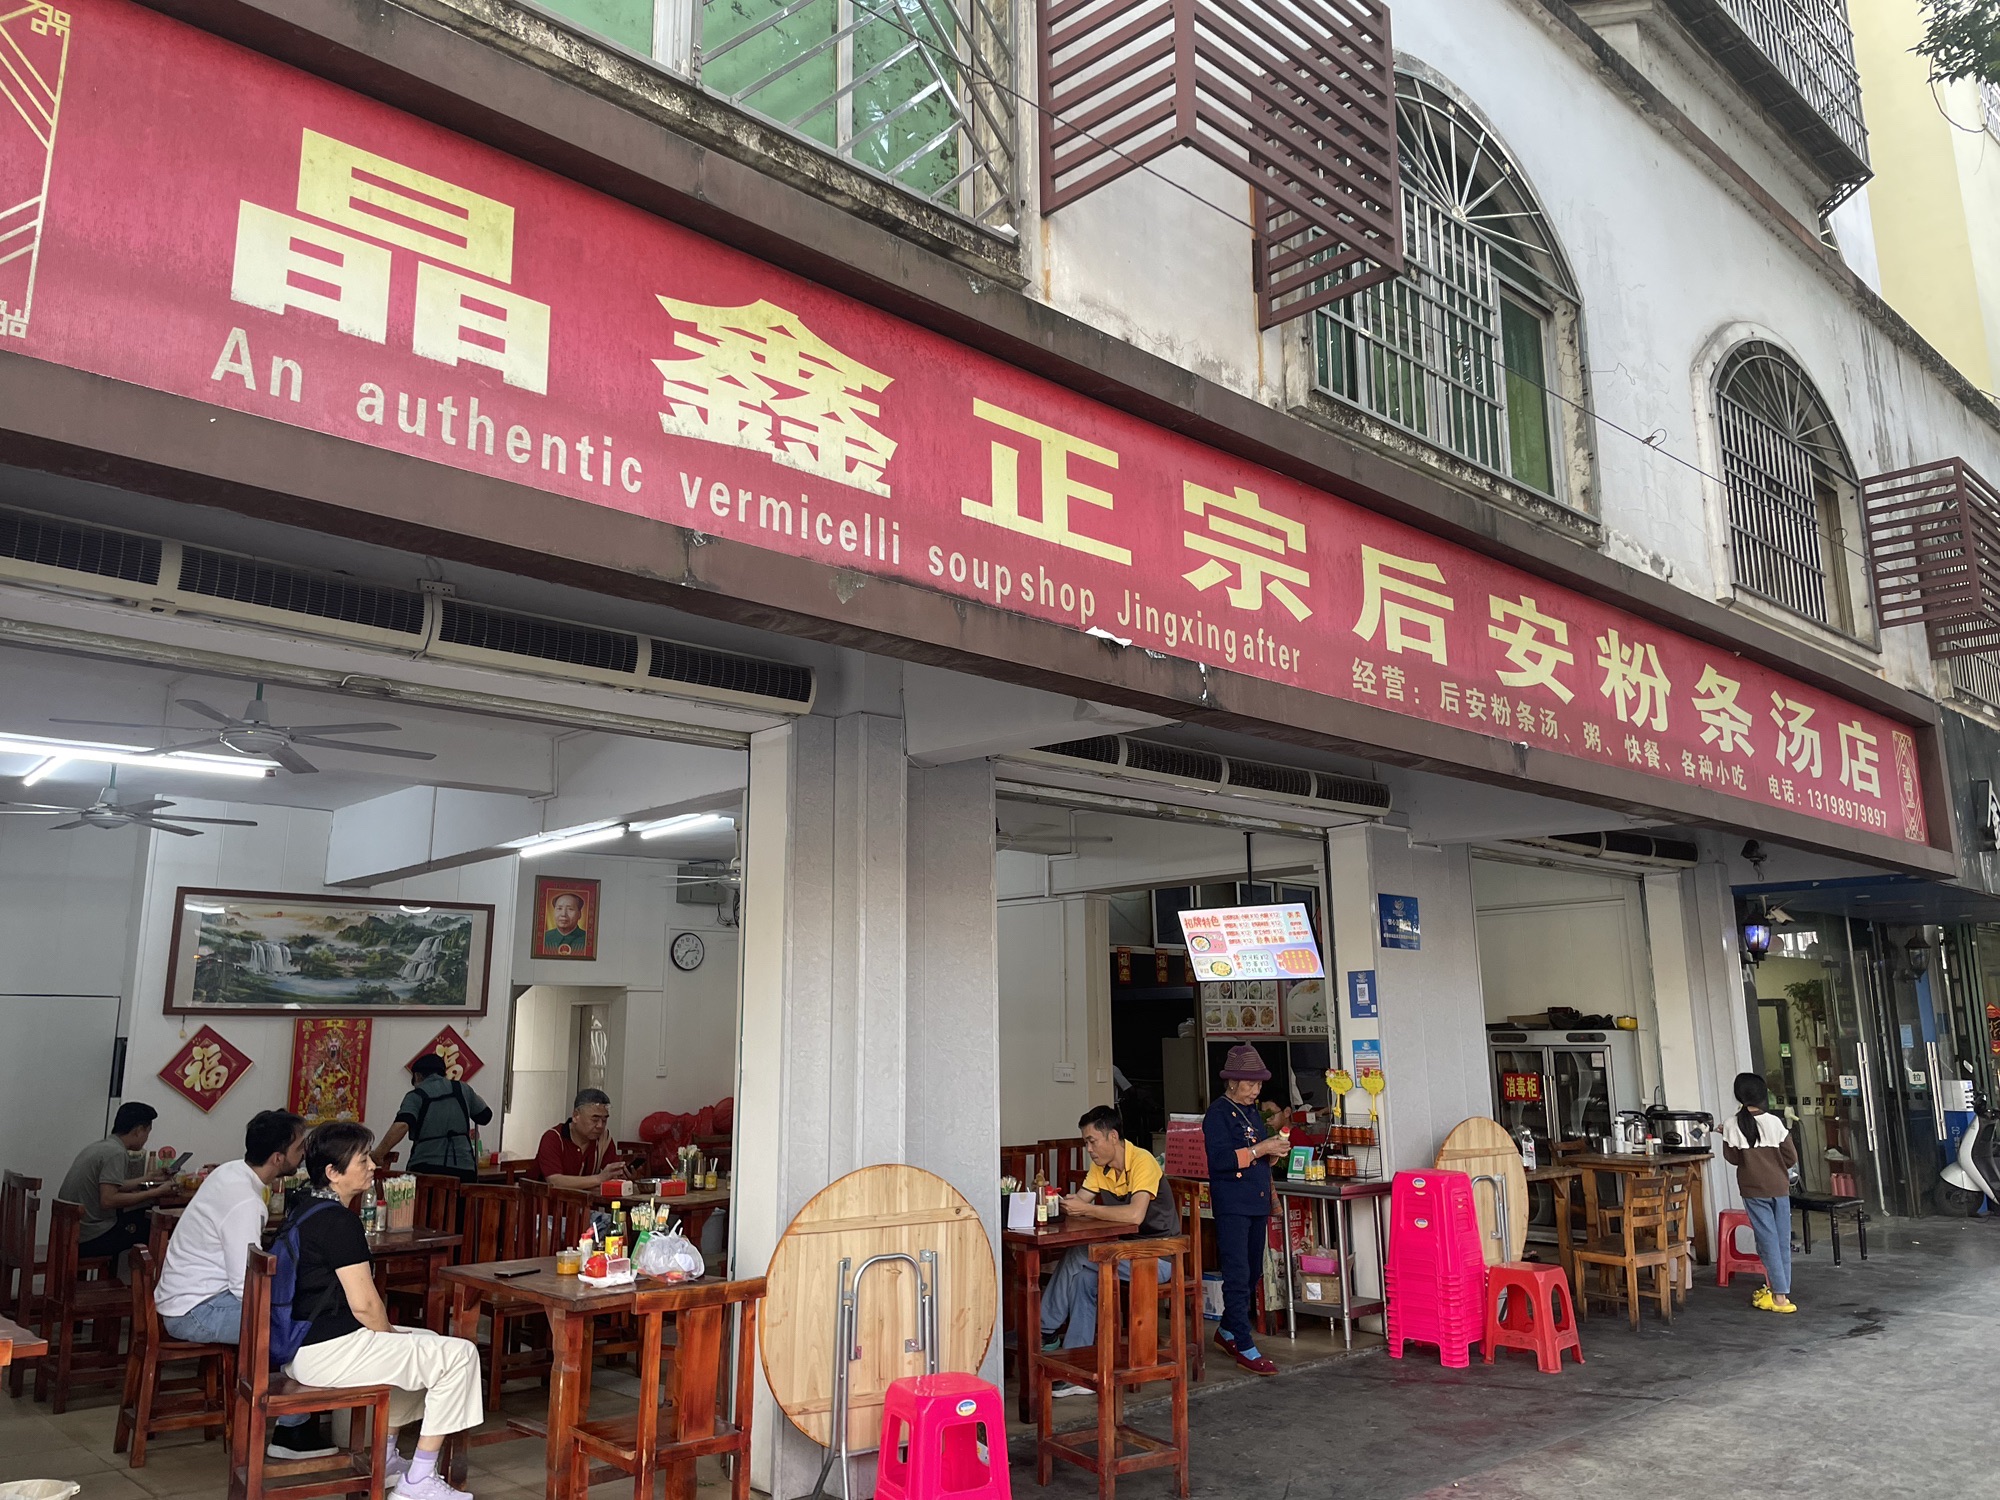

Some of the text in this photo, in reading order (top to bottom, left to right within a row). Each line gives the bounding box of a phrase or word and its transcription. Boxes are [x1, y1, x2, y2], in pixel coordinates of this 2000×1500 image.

[210, 326, 304, 403] An
[355, 379, 643, 495] authentic
[678, 471, 900, 566] vermicelli
[229, 126, 1882, 800] 晶鑫正宗后安粉条汤店
[184, 1042, 230, 1092] 福
[1505, 1076, 1538, 1098] 消毒柜
